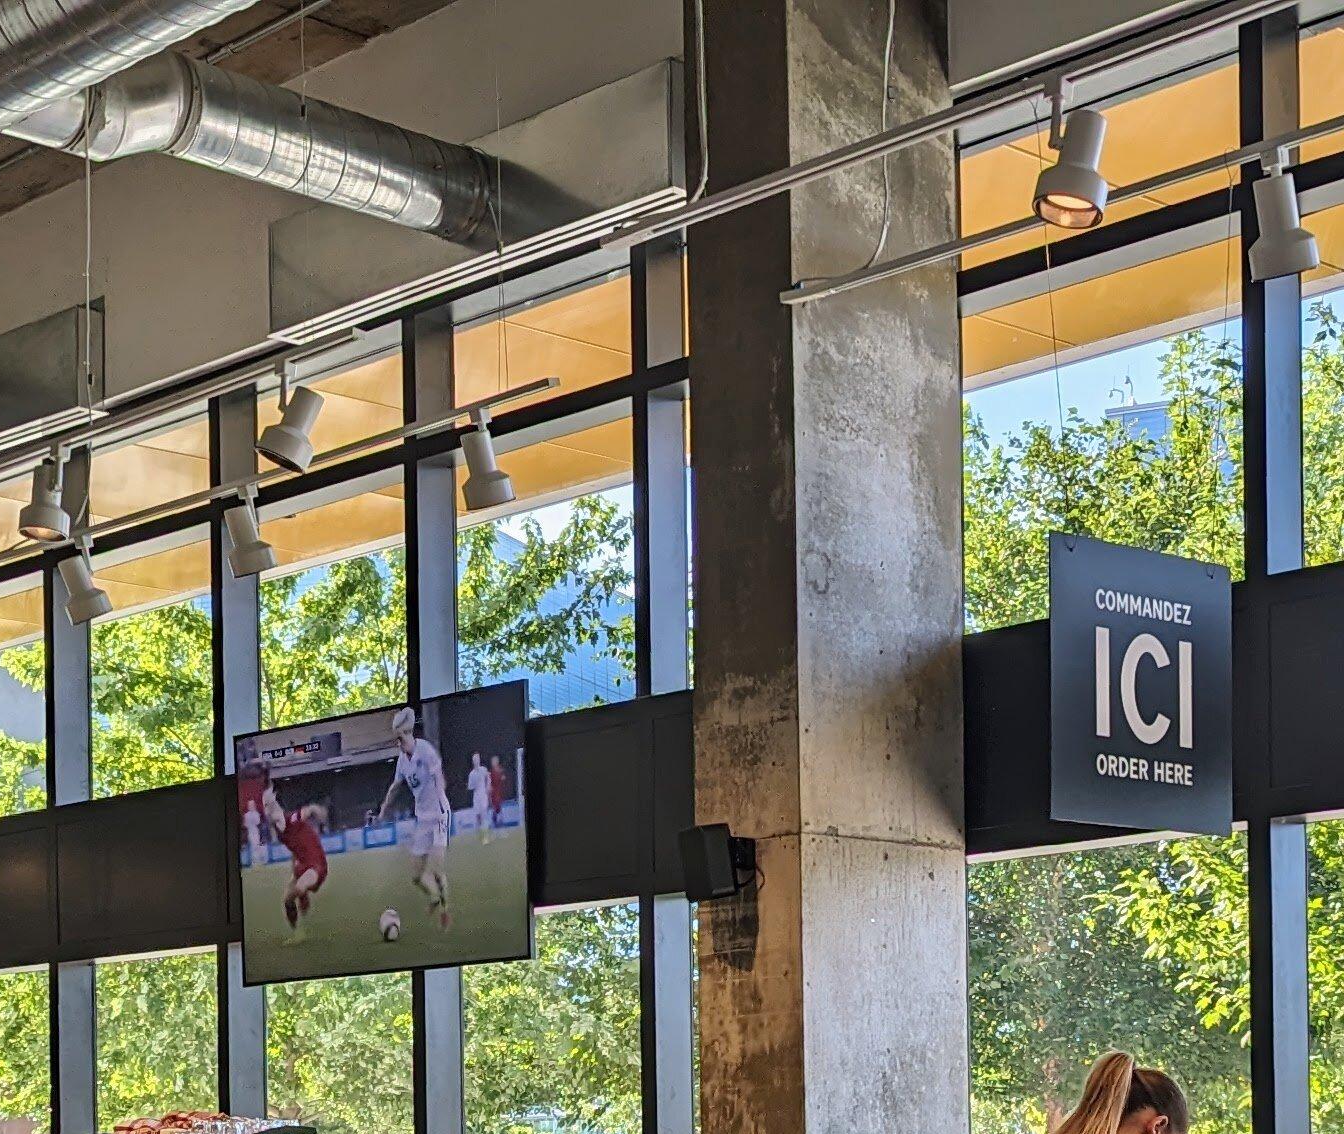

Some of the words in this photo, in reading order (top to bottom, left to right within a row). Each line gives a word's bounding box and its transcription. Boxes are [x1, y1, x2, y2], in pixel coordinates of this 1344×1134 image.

[1095, 588, 1192, 625] COMMANDEZ
[1095, 625, 1193, 749] ICI
[1096, 753, 1148, 781] ORDER
[1154, 760, 1193, 786] HERE
